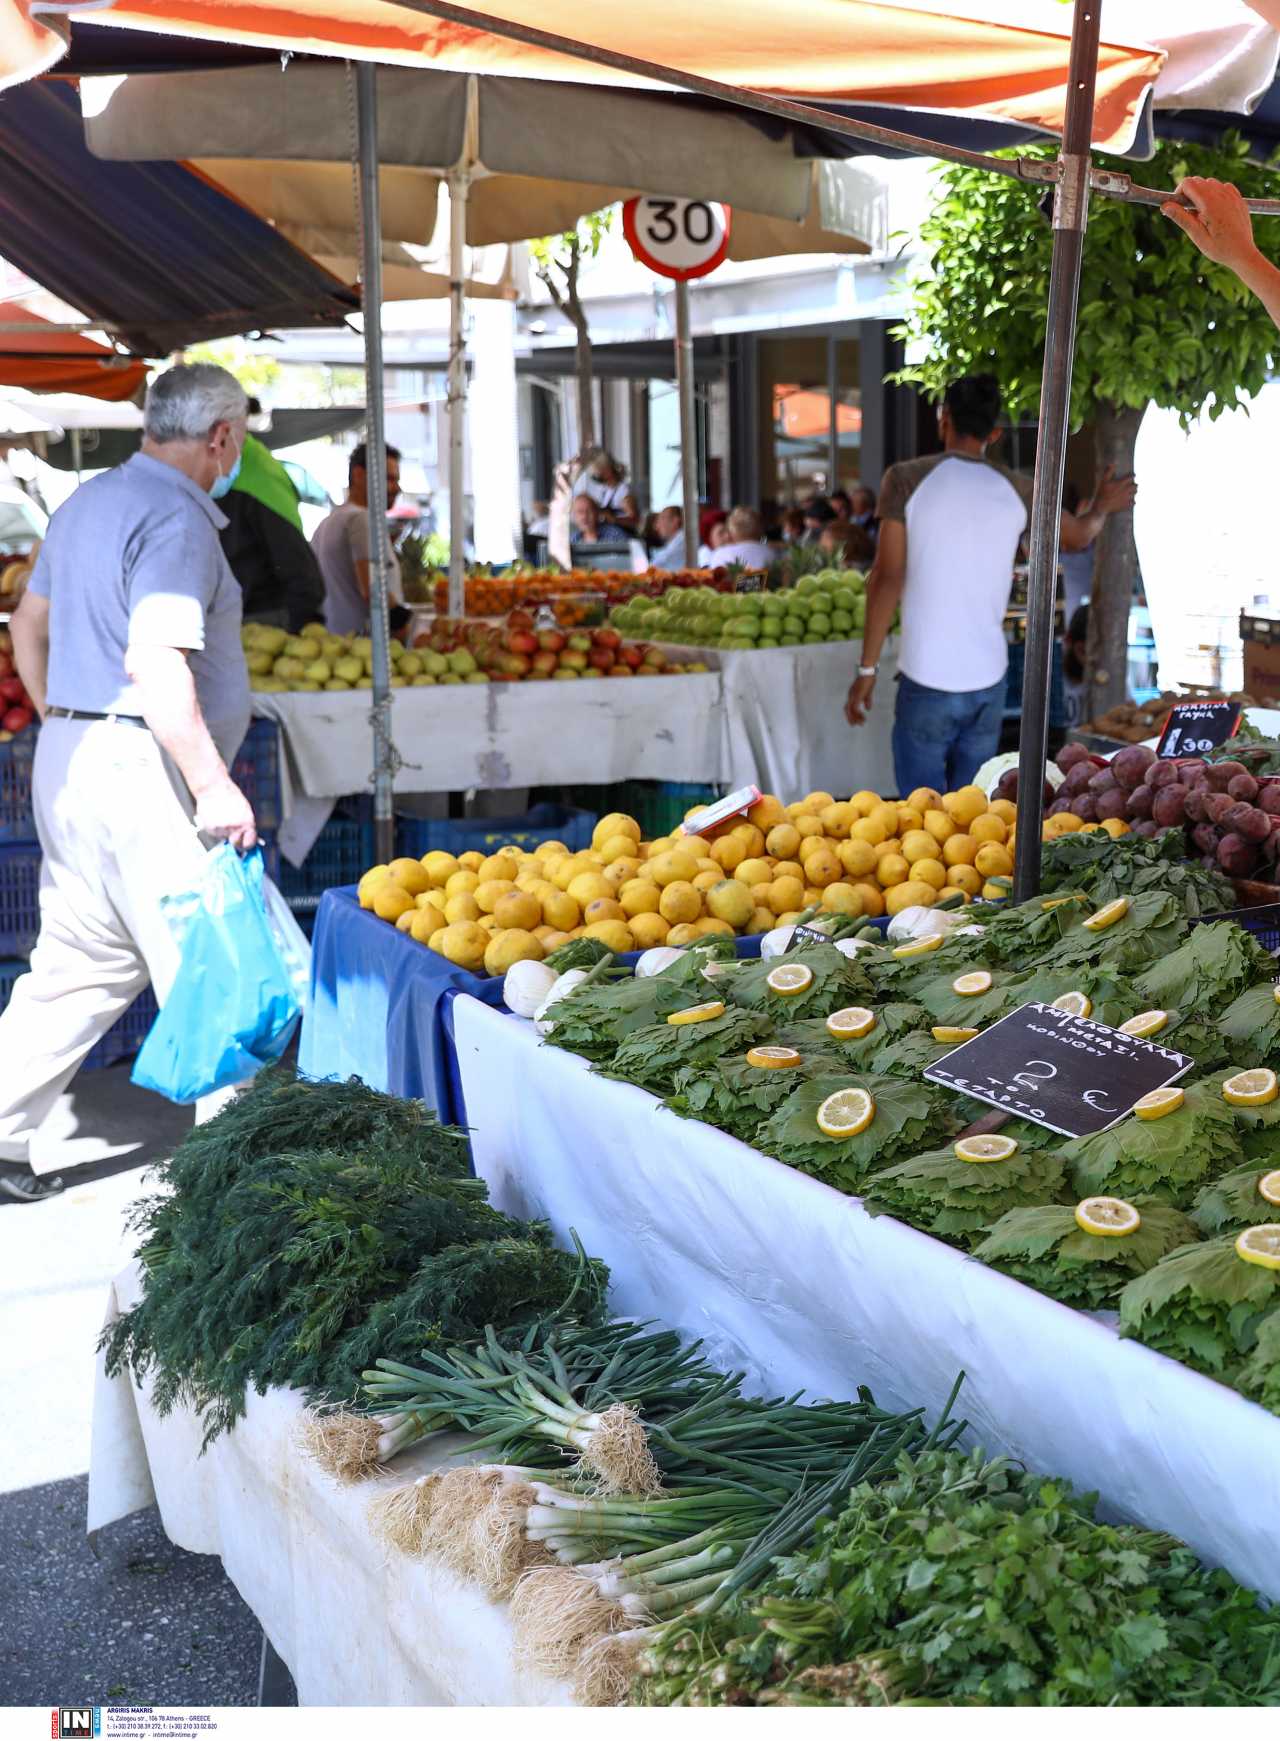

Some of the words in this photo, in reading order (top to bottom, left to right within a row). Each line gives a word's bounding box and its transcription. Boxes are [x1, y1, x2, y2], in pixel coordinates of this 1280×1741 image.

[646, 200, 713, 244] 30
[935, 1069, 1046, 1119] ΤΕΤΑΡΤΟ
[987, 1077, 1020, 1092] ΤΟ
[1013, 1060, 1058, 1091] 2
[1081, 1089, 1118, 1113] €
